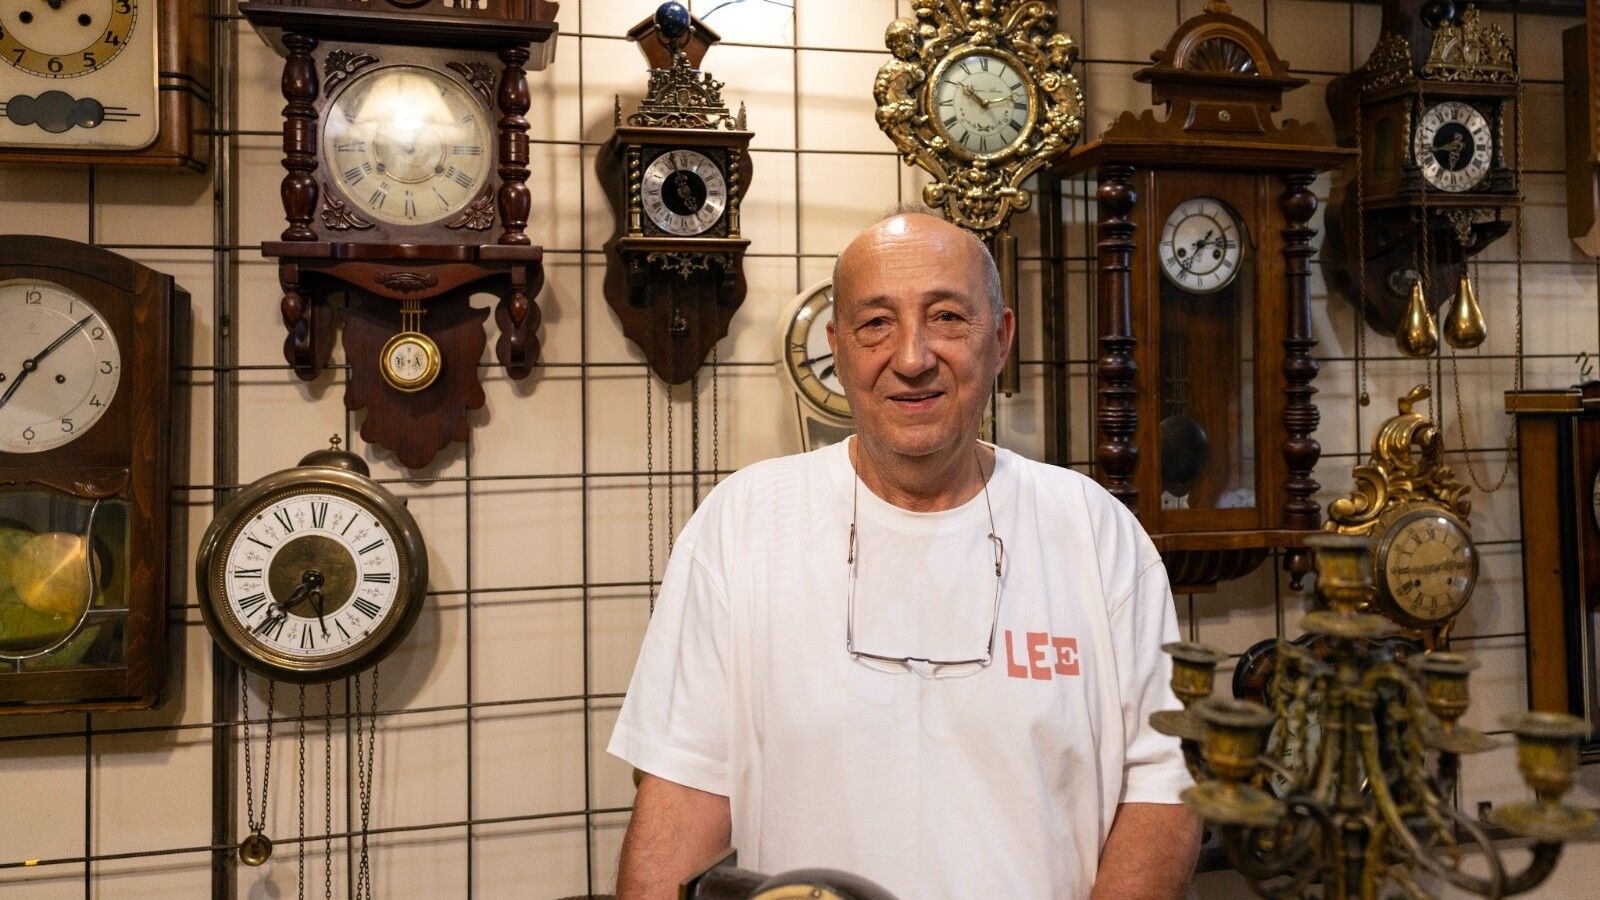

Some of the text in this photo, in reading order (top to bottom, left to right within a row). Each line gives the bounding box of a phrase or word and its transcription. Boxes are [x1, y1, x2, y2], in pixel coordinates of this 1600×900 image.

[115, 0, 132, 14] 3
[104, 31, 120, 46] 4
[13, 49, 26, 67] 7
[47, 57, 63, 73] 6
[83, 52, 97, 68] 5
[453, 146, 480, 156] III
[25, 290, 42, 304] 12
[69, 301, 74, 315] 1
[91, 327, 105, 341] 2
[100, 360, 113, 375] 3
[89, 394, 102, 408] 4
[22, 426, 36, 441] 6
[61, 418, 74, 433] 5
[273, 507, 295, 535] XI
[310, 502, 329, 529] XII
[341, 513, 359, 536] I
[246, 532, 273, 552] X
[357, 538, 385, 556] II
[234, 566, 263, 579] IX
[362, 572, 391, 584] III
[237, 592, 267, 619] VIII
[351, 596, 382, 620] IIII
[300, 622, 315, 650] VI
[334, 618, 351, 642] V
[1005, 630, 1080, 680] LEE
